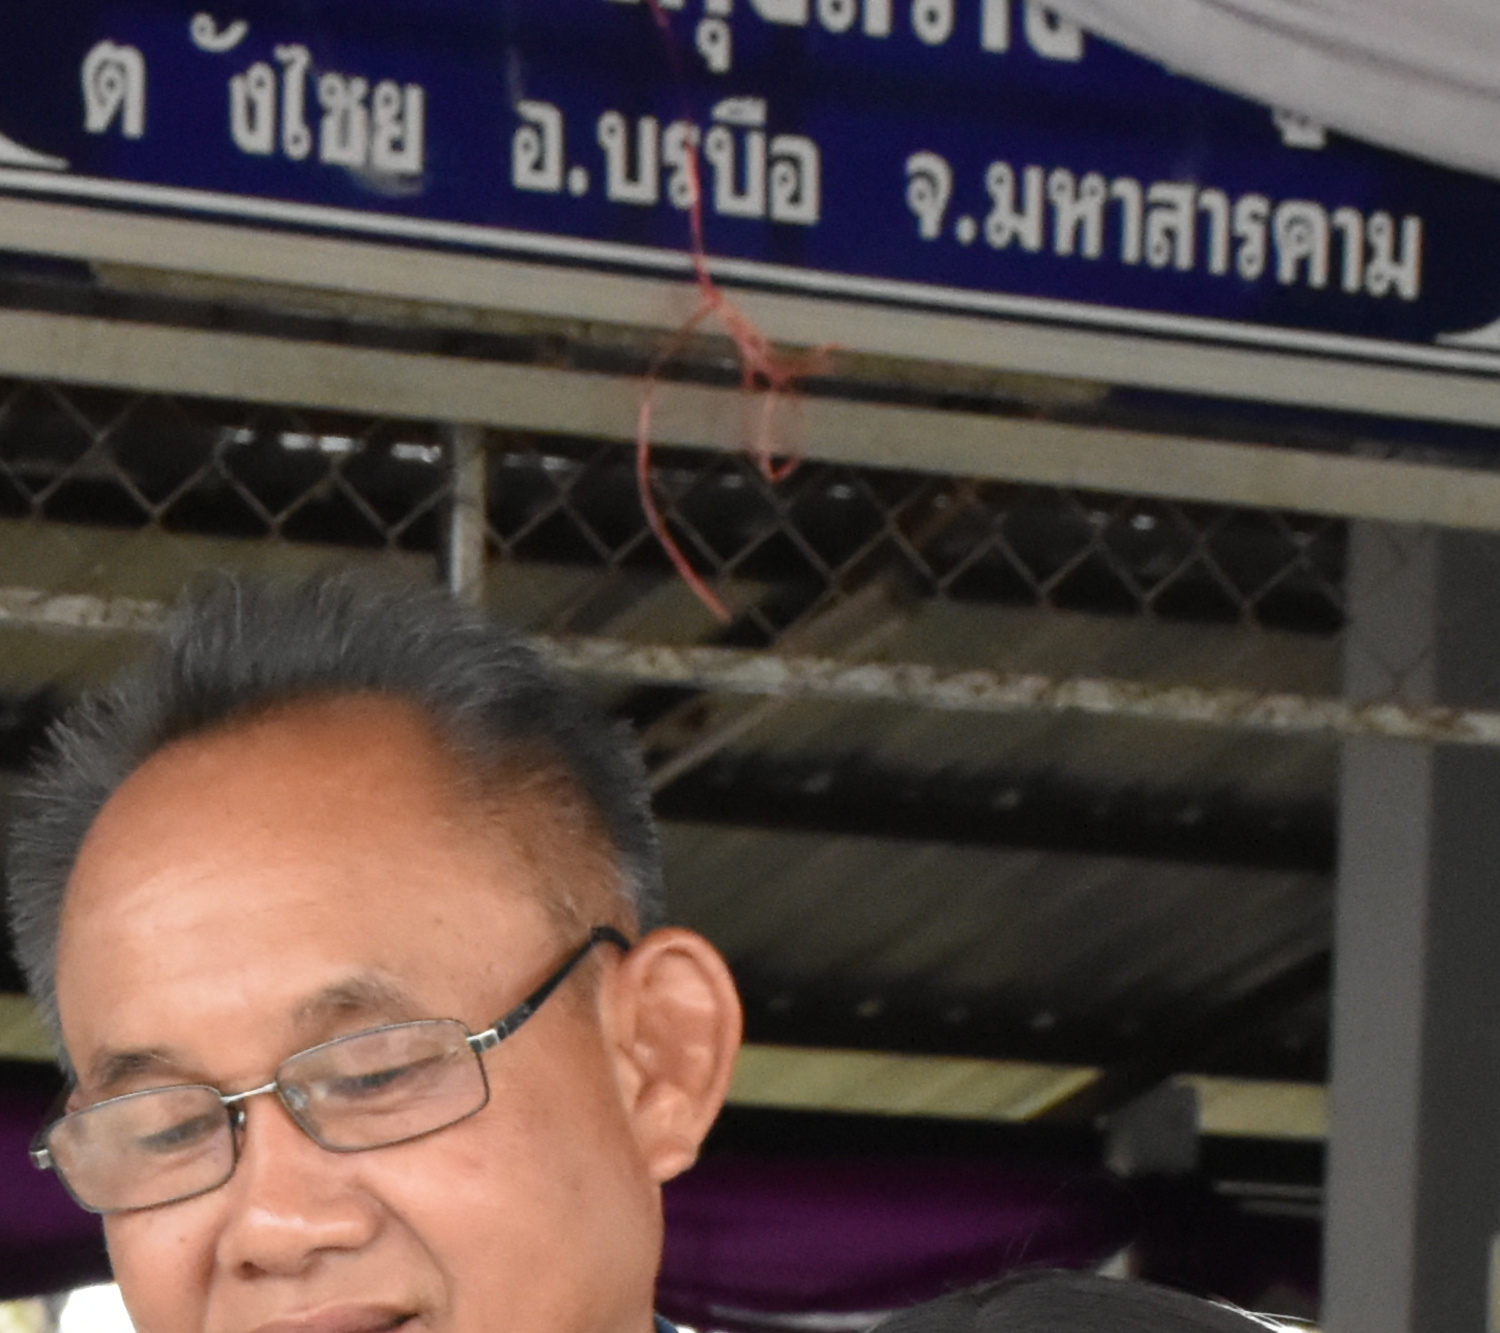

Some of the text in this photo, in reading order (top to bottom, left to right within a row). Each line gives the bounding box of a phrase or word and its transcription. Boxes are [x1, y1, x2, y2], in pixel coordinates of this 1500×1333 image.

[511, 97, 821, 226] อ.บรบือ
[905, 151, 1422, 300] จ.มหาสารคาม
